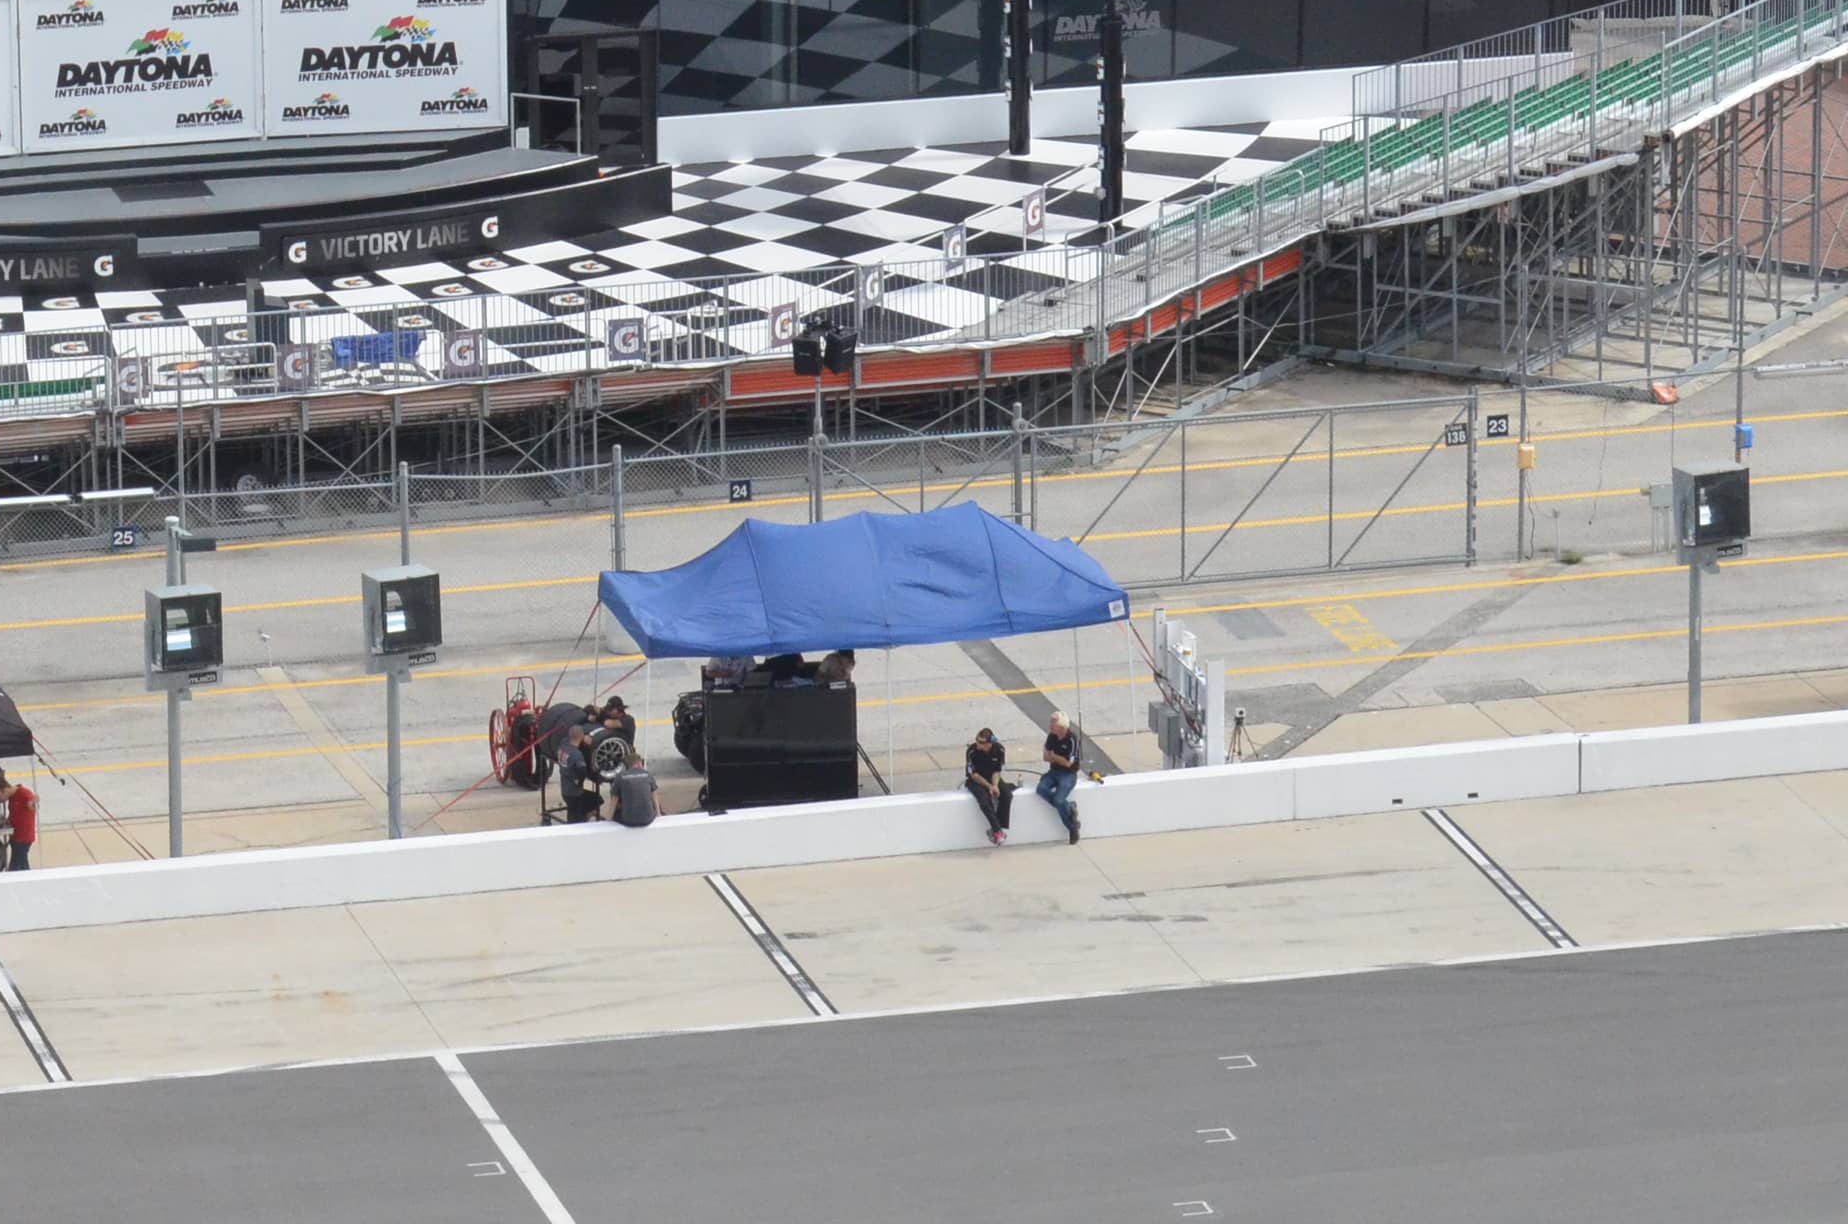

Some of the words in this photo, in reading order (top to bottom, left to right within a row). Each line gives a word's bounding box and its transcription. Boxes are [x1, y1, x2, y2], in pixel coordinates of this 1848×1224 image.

[172, 1, 240, 17] DAYTONA
[37, 10, 105, 26] DAYTONA
[300, 41, 459, 72] DAYTONA
[56, 52, 214, 88] DAYTONA
[298, 69, 391, 83] INTERNATIONAL
[395, 66, 459, 79] SPEEDWAY
[54, 82, 147, 98] INTERNATIONAL
[150, 78, 214, 92] SPEEDWAY
[282, 104, 350, 119] DAYTONA
[420, 98, 489, 113] DAYTONA
[175, 109, 243, 125] DAYTONA
[39, 119, 107, 134] DAYTONA
[320, 229, 413, 261] VICTORY
[416, 221, 471, 250] LANE
[19, 257, 81, 281] LANE
[1488, 419, 1507, 433] 23
[732, 484, 748, 498] 24
[113, 531, 134, 545] 25
